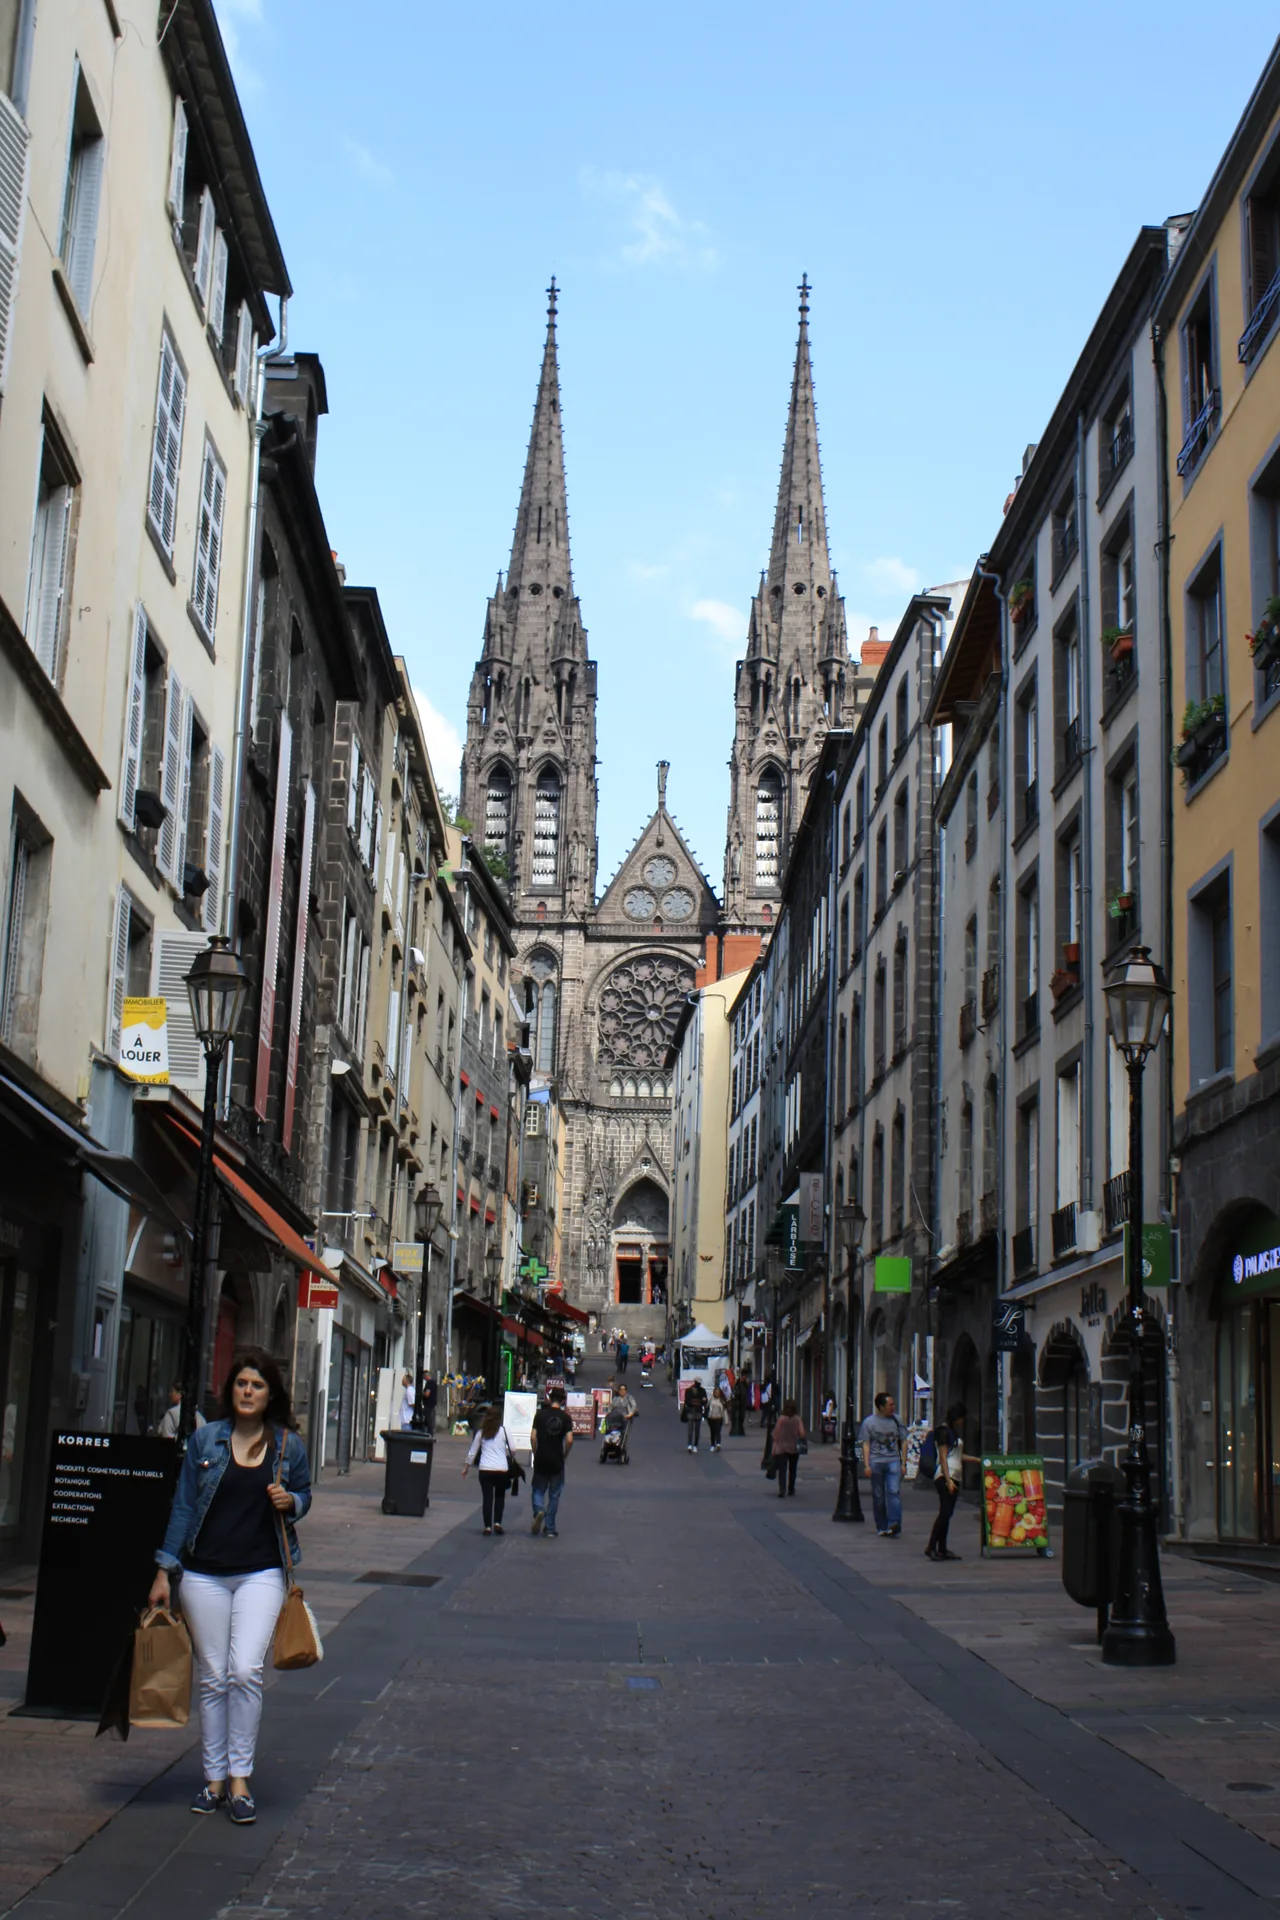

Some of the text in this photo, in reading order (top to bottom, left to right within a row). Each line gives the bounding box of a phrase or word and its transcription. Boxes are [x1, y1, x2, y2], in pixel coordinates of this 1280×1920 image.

[133, 1033, 143, 1048] À
[121, 1049, 161, 1062] LOUER
[789, 1214, 797, 1266] LARBIOSE
[1245, 1246, 1280, 1278] PALAIS DE
[58, 1435, 110, 1447] KORRES
[55, 1464, 85, 1473] PRODUITS
[132, 1470, 163, 1478] NATURELS
[54, 1477, 90, 1486] BOTANIQUE
[53, 1490, 102, 1499] COOPERATIONS
[52, 1503, 95, 1512] EXTRACTIONS
[50, 1515, 88, 1524] RECHERCHE
